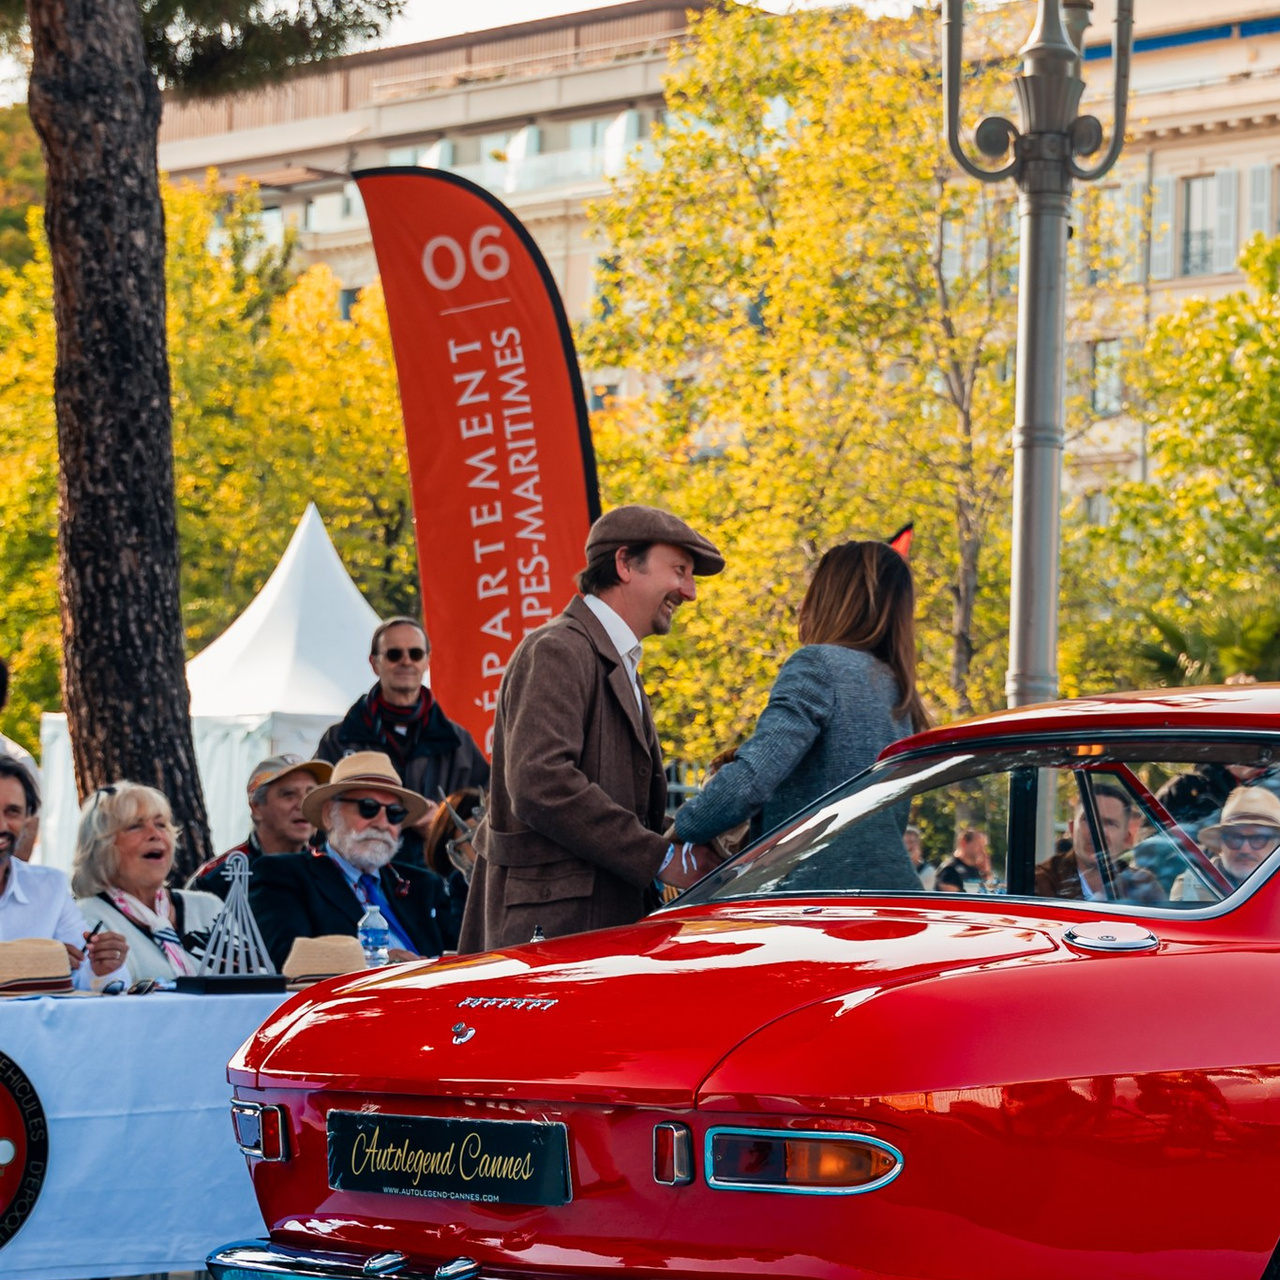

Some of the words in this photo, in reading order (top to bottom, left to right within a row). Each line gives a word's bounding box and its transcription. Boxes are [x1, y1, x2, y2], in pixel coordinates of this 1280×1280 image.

[421, 225, 510, 290] 06
[490, 326, 553, 636] PES-MARITIMES
[0, 1057, 45, 1141] EHICULES
[351, 1125, 456, 1185] Autolegend
[459, 1132, 535, 1181] Cannes
[382, 1186, 500, 1202] WWW.AUTOLEGEND-CANNES.COM
